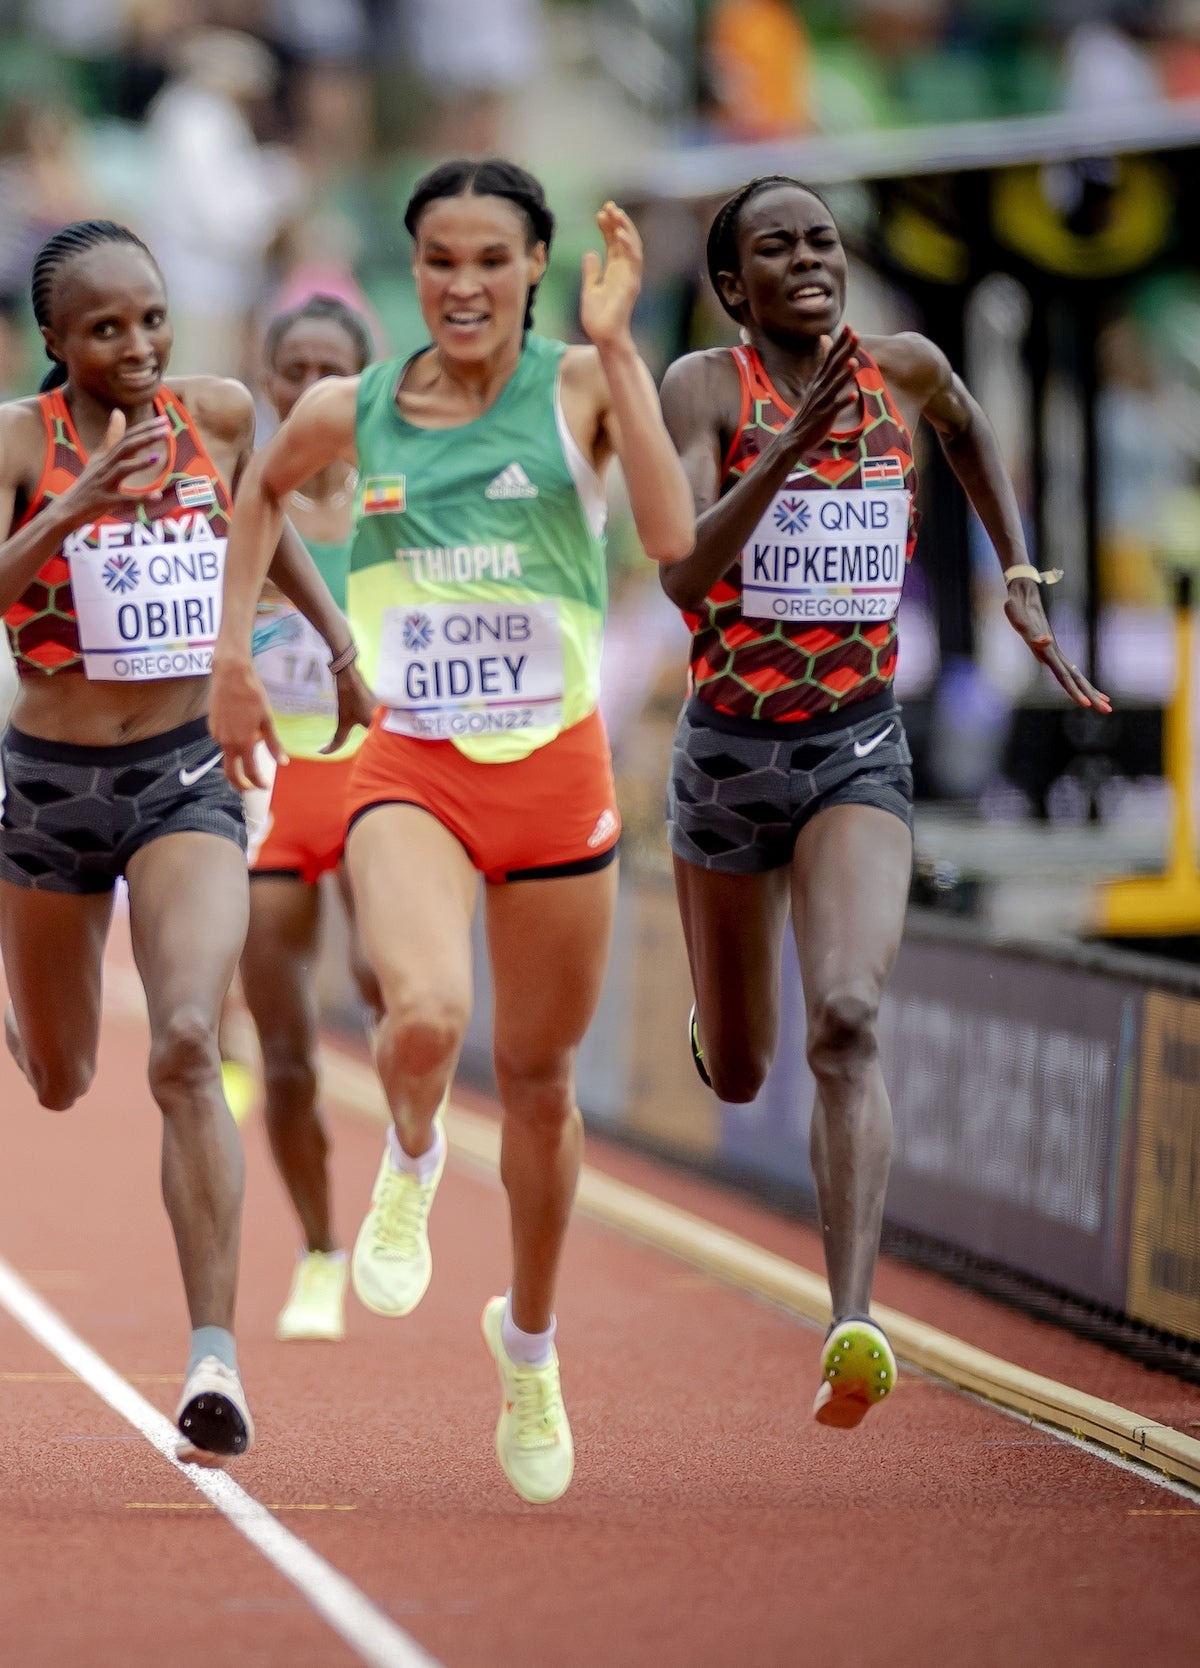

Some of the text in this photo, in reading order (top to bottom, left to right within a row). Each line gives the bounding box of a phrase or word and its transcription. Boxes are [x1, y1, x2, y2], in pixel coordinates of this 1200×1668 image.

[63, 512, 215, 551] KENYA
[820, 501, 888, 531] QNB
[149, 552, 219, 585] QNB
[753, 544, 899, 582] KIPKEMBOI
[118, 598, 214, 640] OBIRI
[773, 599, 887, 616] OREGON22
[443, 613, 531, 645] QNB
[113, 652, 212, 676] OREGON2
[406, 655, 527, 700] GIDEY
